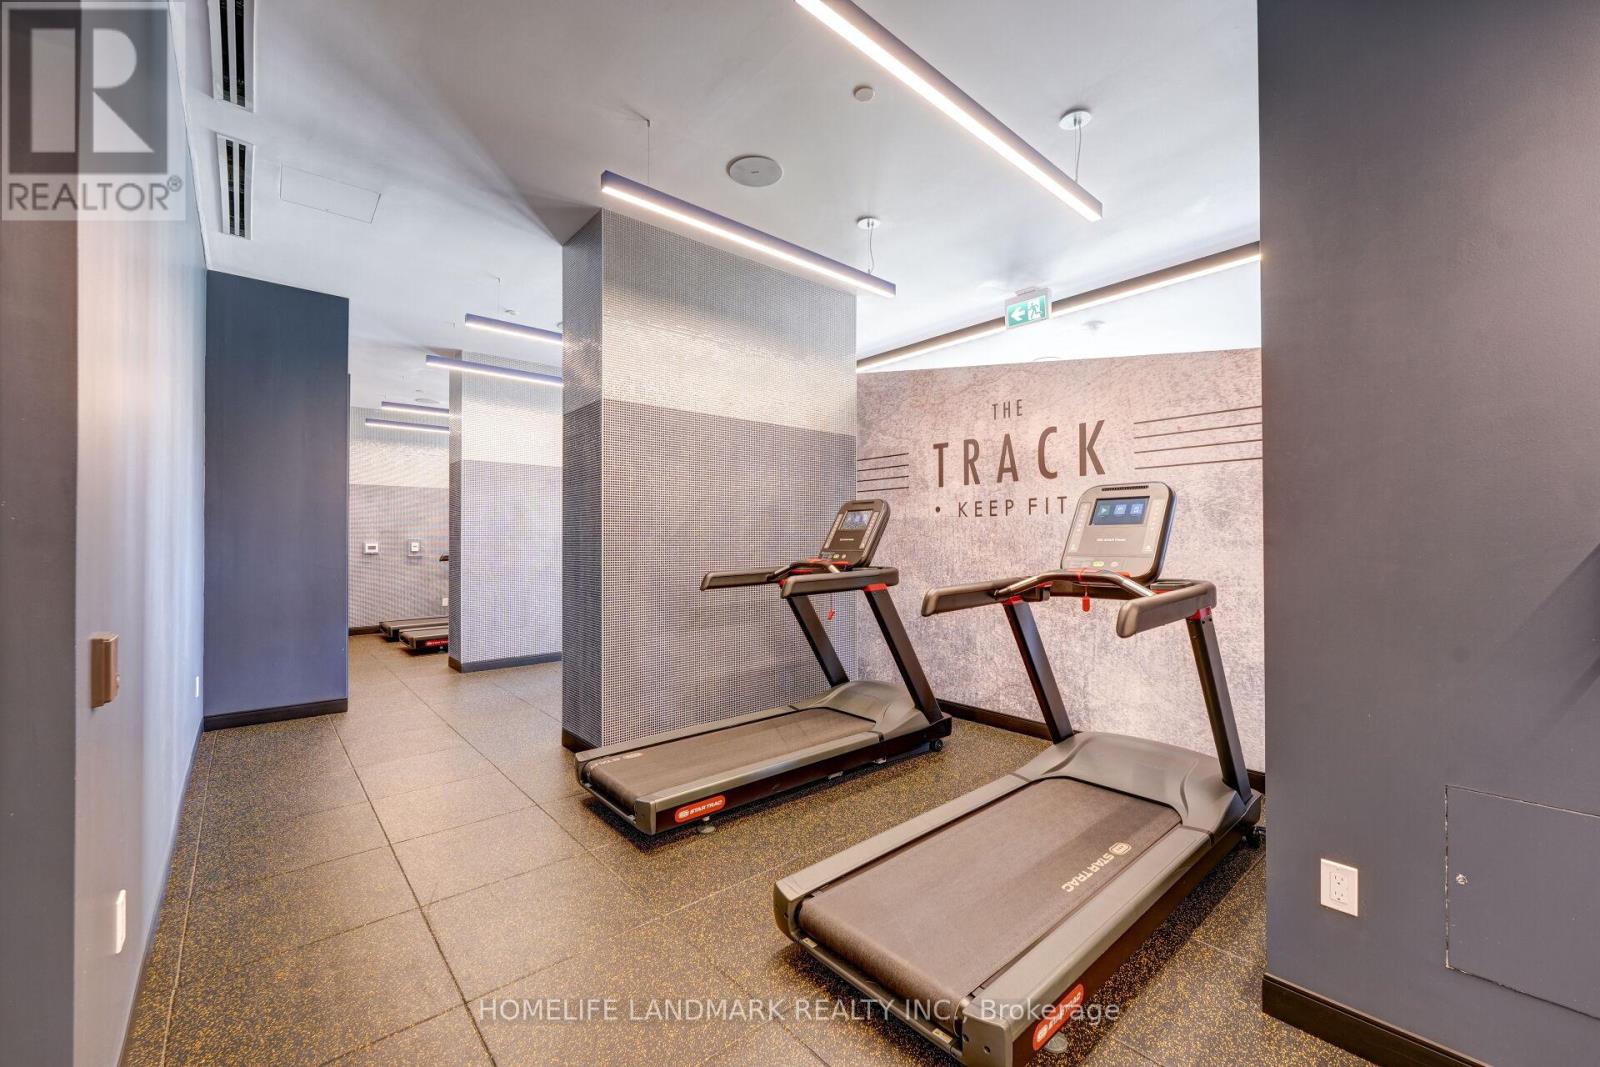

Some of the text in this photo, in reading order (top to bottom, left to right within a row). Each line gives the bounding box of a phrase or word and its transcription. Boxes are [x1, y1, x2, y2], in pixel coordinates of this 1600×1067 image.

[992, 399, 1023, 420] THE
[933, 420, 1106, 488] TRACK
[958, 495, 1068, 518] KEEP FIT
[689, 805, 706, 815] STAR
[1061, 852, 1115, 893] STAR TRAC
